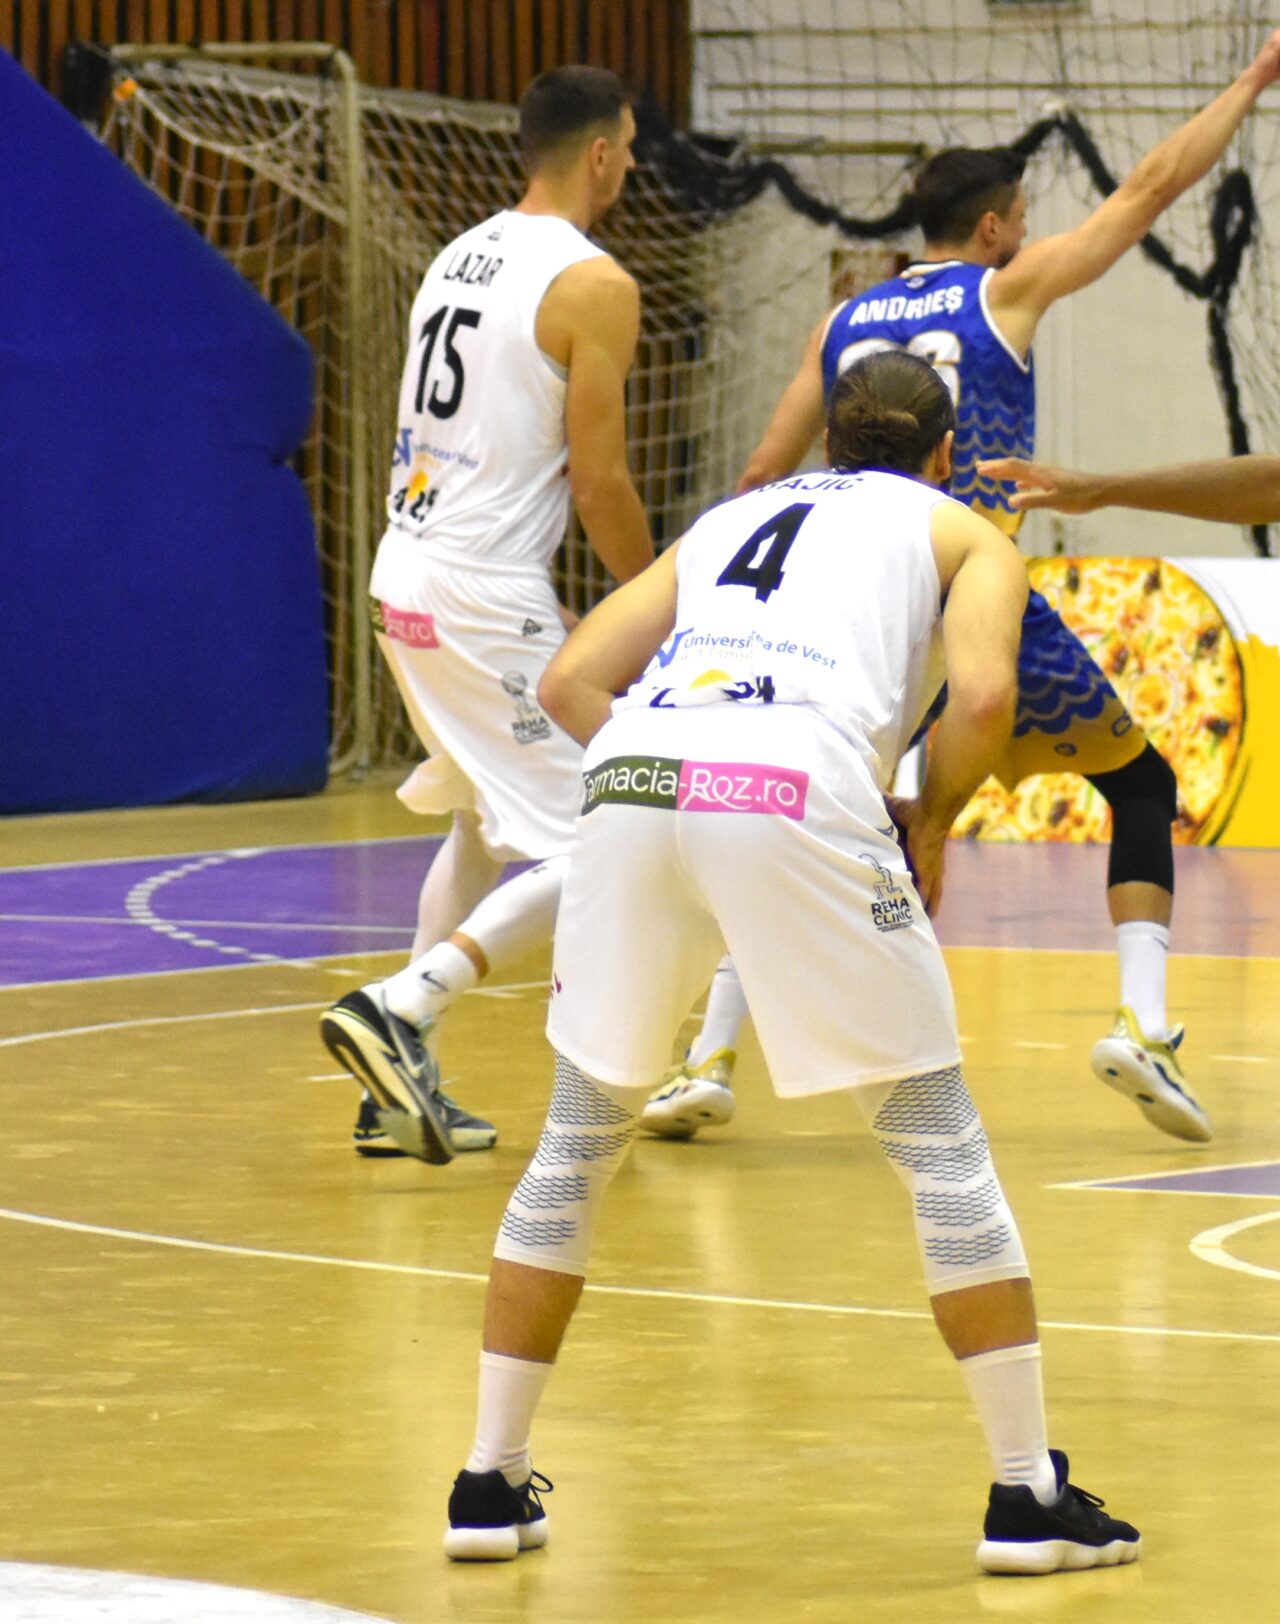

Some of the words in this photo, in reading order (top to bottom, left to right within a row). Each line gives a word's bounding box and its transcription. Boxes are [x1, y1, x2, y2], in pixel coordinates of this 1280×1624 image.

[443, 250, 503, 287] LAZAR
[848, 285, 965, 326] ANDRIEȘ
[414, 304, 482, 420] 15
[715, 502, 816, 604] 4
[776, 640, 798, 654] de
[802, 645, 837, 669] Vest
[871, 897, 910, 915] REHA
[873, 909, 912, 926] CLINIC
